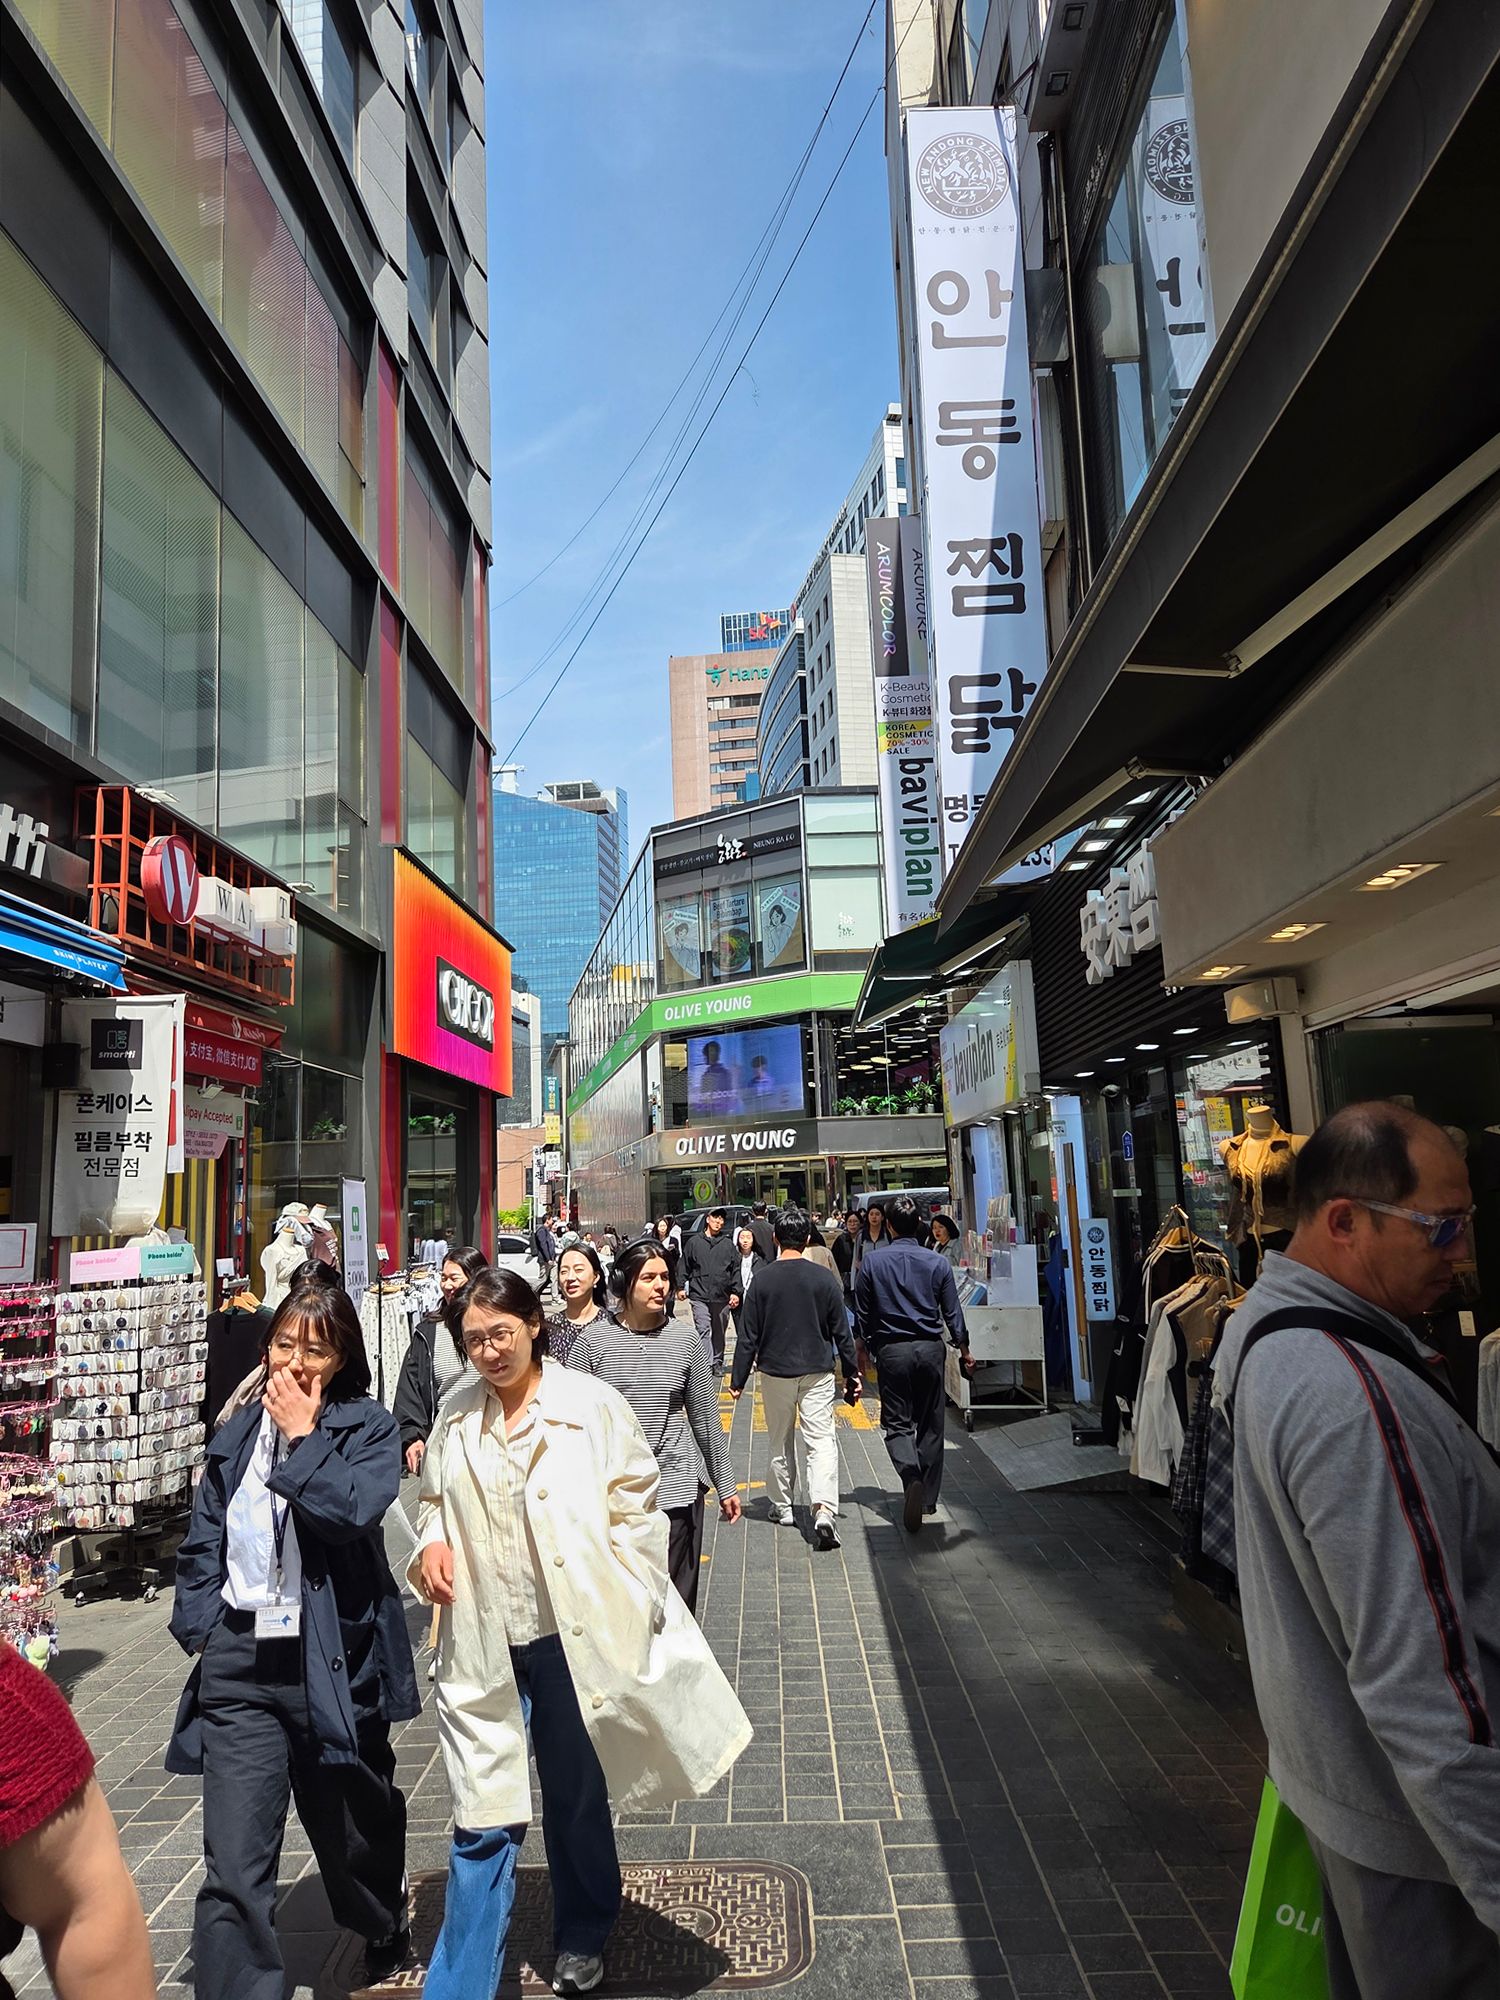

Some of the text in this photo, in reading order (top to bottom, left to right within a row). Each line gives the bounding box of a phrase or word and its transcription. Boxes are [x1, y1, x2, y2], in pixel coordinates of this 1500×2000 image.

[920, 137, 1006, 194] NEW ANDONG ZZIMDAK
[876, 541, 897, 658] ARUMCOLOR
[748, 626, 769, 641] SK
[728, 666, 771, 683] Hana
[880, 682, 930, 693] K-Beauty
[885, 723, 917, 732] KOREA
[886, 731, 934, 740] COSMETIC
[886, 747, 910, 755] SALE
[899, 757, 940, 897] baviplan
[664, 995, 752, 1021] OLIVE YOUNG
[953, 1022, 996, 1096] baviplan
[75, 1092, 153, 1115] 폰케이스
[203, 1109, 233, 1126] Accepted
[74, 1131, 153, 1153] 필름부착
[675, 1128, 797, 1156] OLIVE YOUNG
[83, 1156, 140, 1178] 전문점
[147, 1251, 183, 1260] Phone holder
[1088, 1247, 1109, 1312] 안동찜닭
